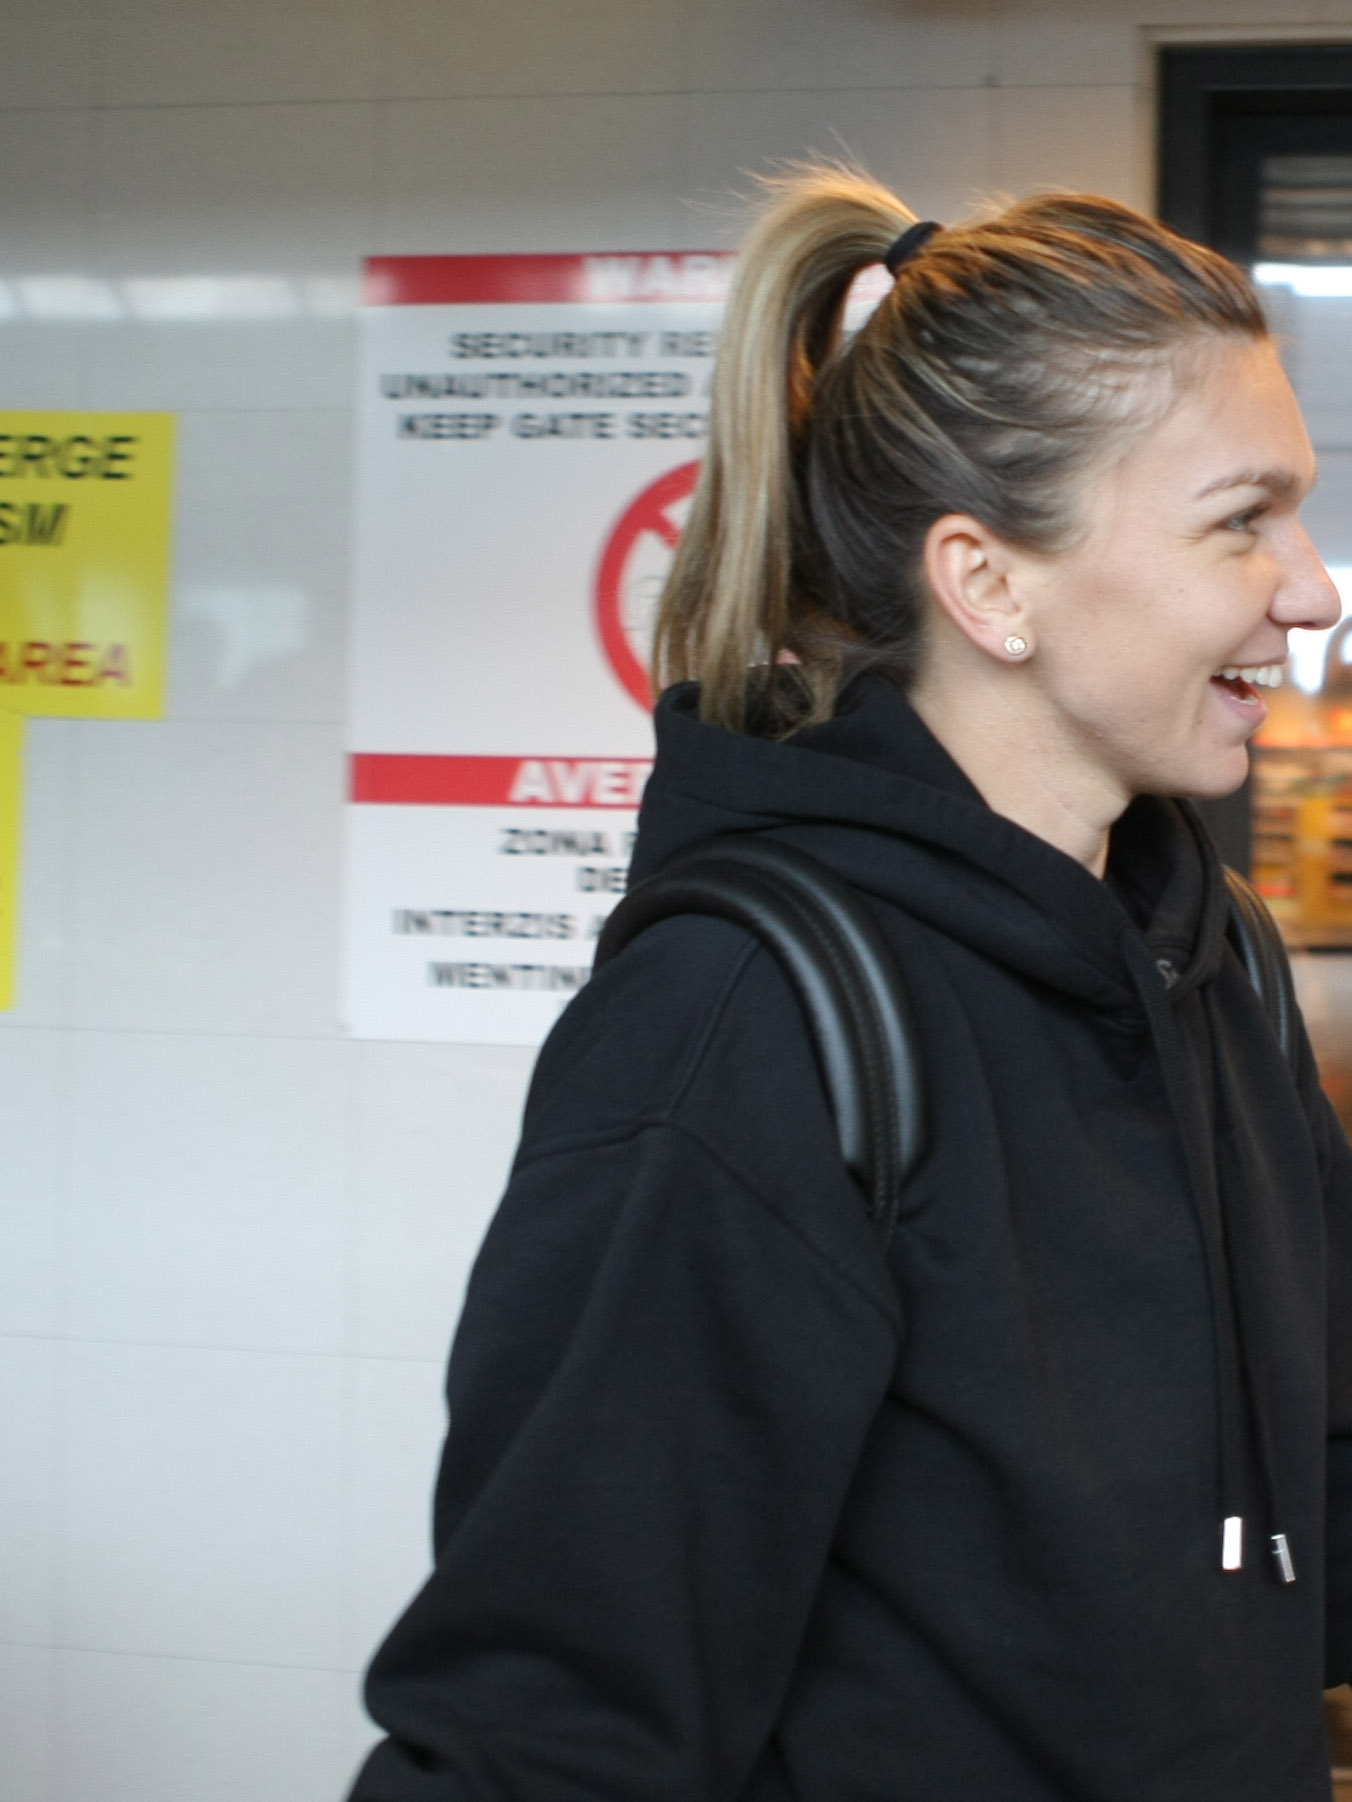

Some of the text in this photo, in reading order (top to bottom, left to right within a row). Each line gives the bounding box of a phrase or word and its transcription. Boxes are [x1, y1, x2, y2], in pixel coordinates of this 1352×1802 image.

[584, 256, 737, 297] WAR
[450, 331, 650, 358] SECURITY
[380, 371, 692, 399] UNAUTHORIZED
[398, 412, 499, 439] KEEP
[511, 411, 614, 439] GATE
[500, 827, 612, 857] ZONA
[392, 908, 576, 939] INTERZIS
